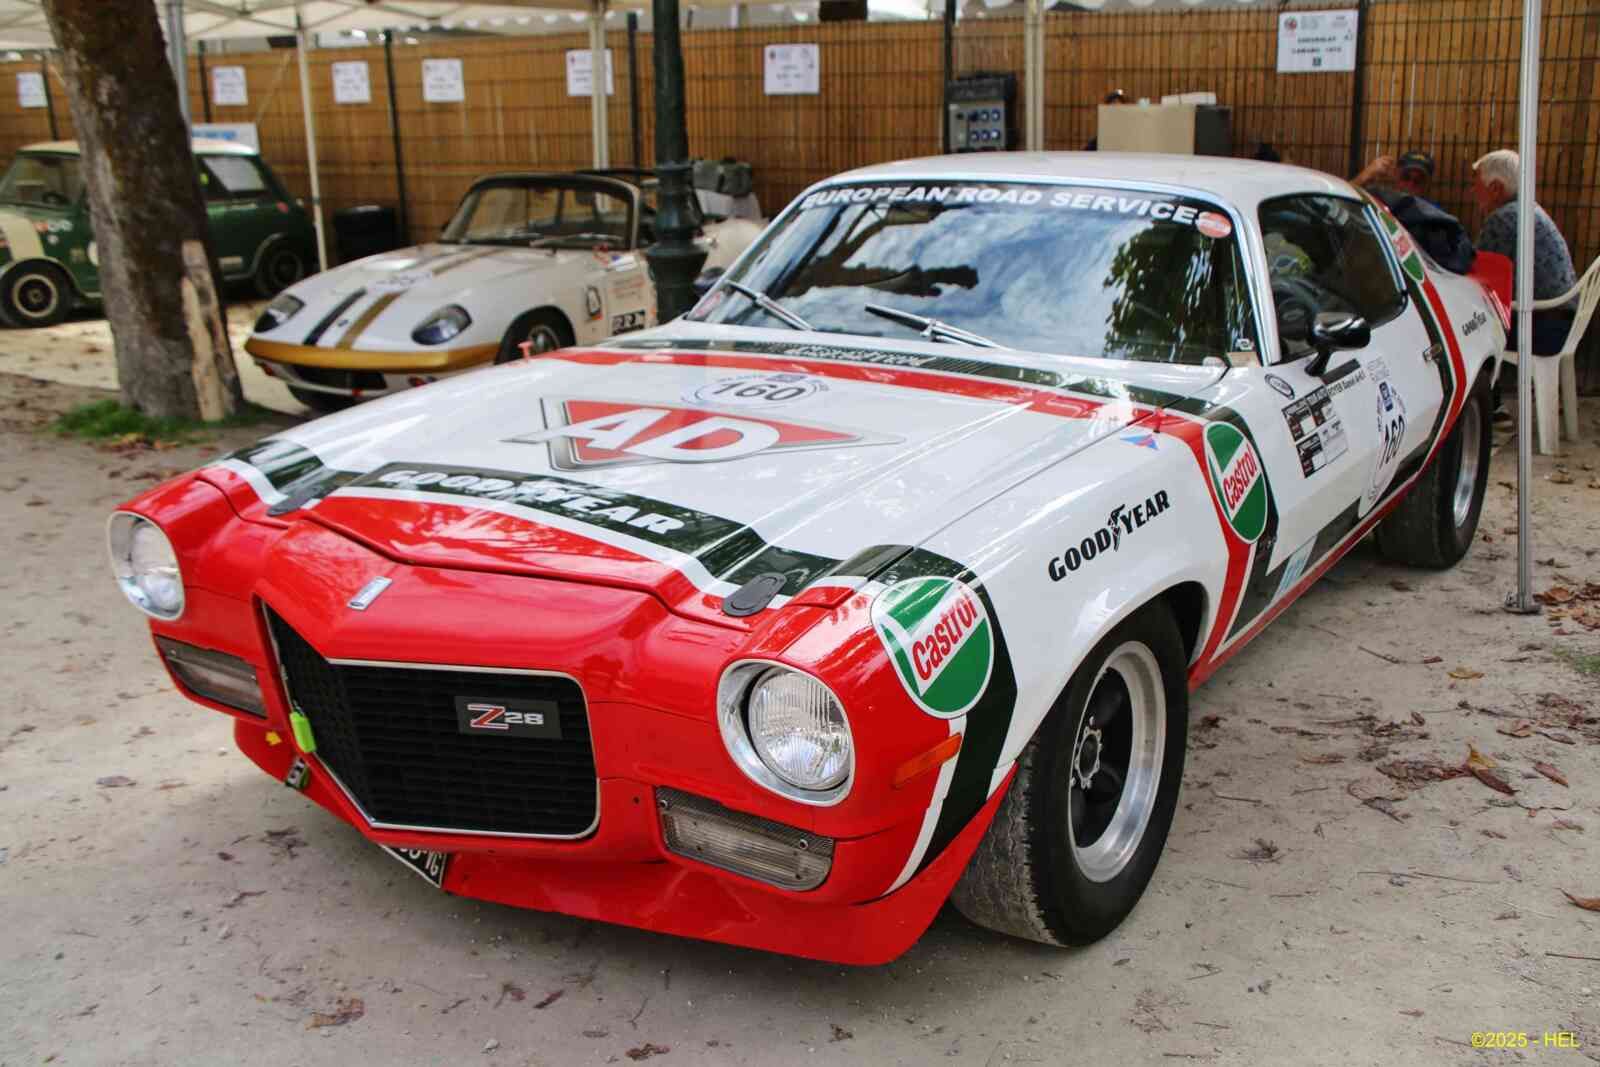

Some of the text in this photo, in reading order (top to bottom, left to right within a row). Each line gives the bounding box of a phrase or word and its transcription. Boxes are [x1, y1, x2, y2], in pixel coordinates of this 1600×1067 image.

[801, 186, 952, 209] EUROPEAN
[956, 187, 1042, 205] ROAD
[713, 381, 806, 401] 160
[501, 407, 781, 464] AD
[1379, 414, 1406, 471] 160
[379, 470, 686, 534] GOODYEAR
[1222, 443, 1258, 511] Castrol
[1048, 489, 1170, 582] GOODYEAR
[912, 593, 978, 681] Castrol
[467, 703, 545, 730] Z28
